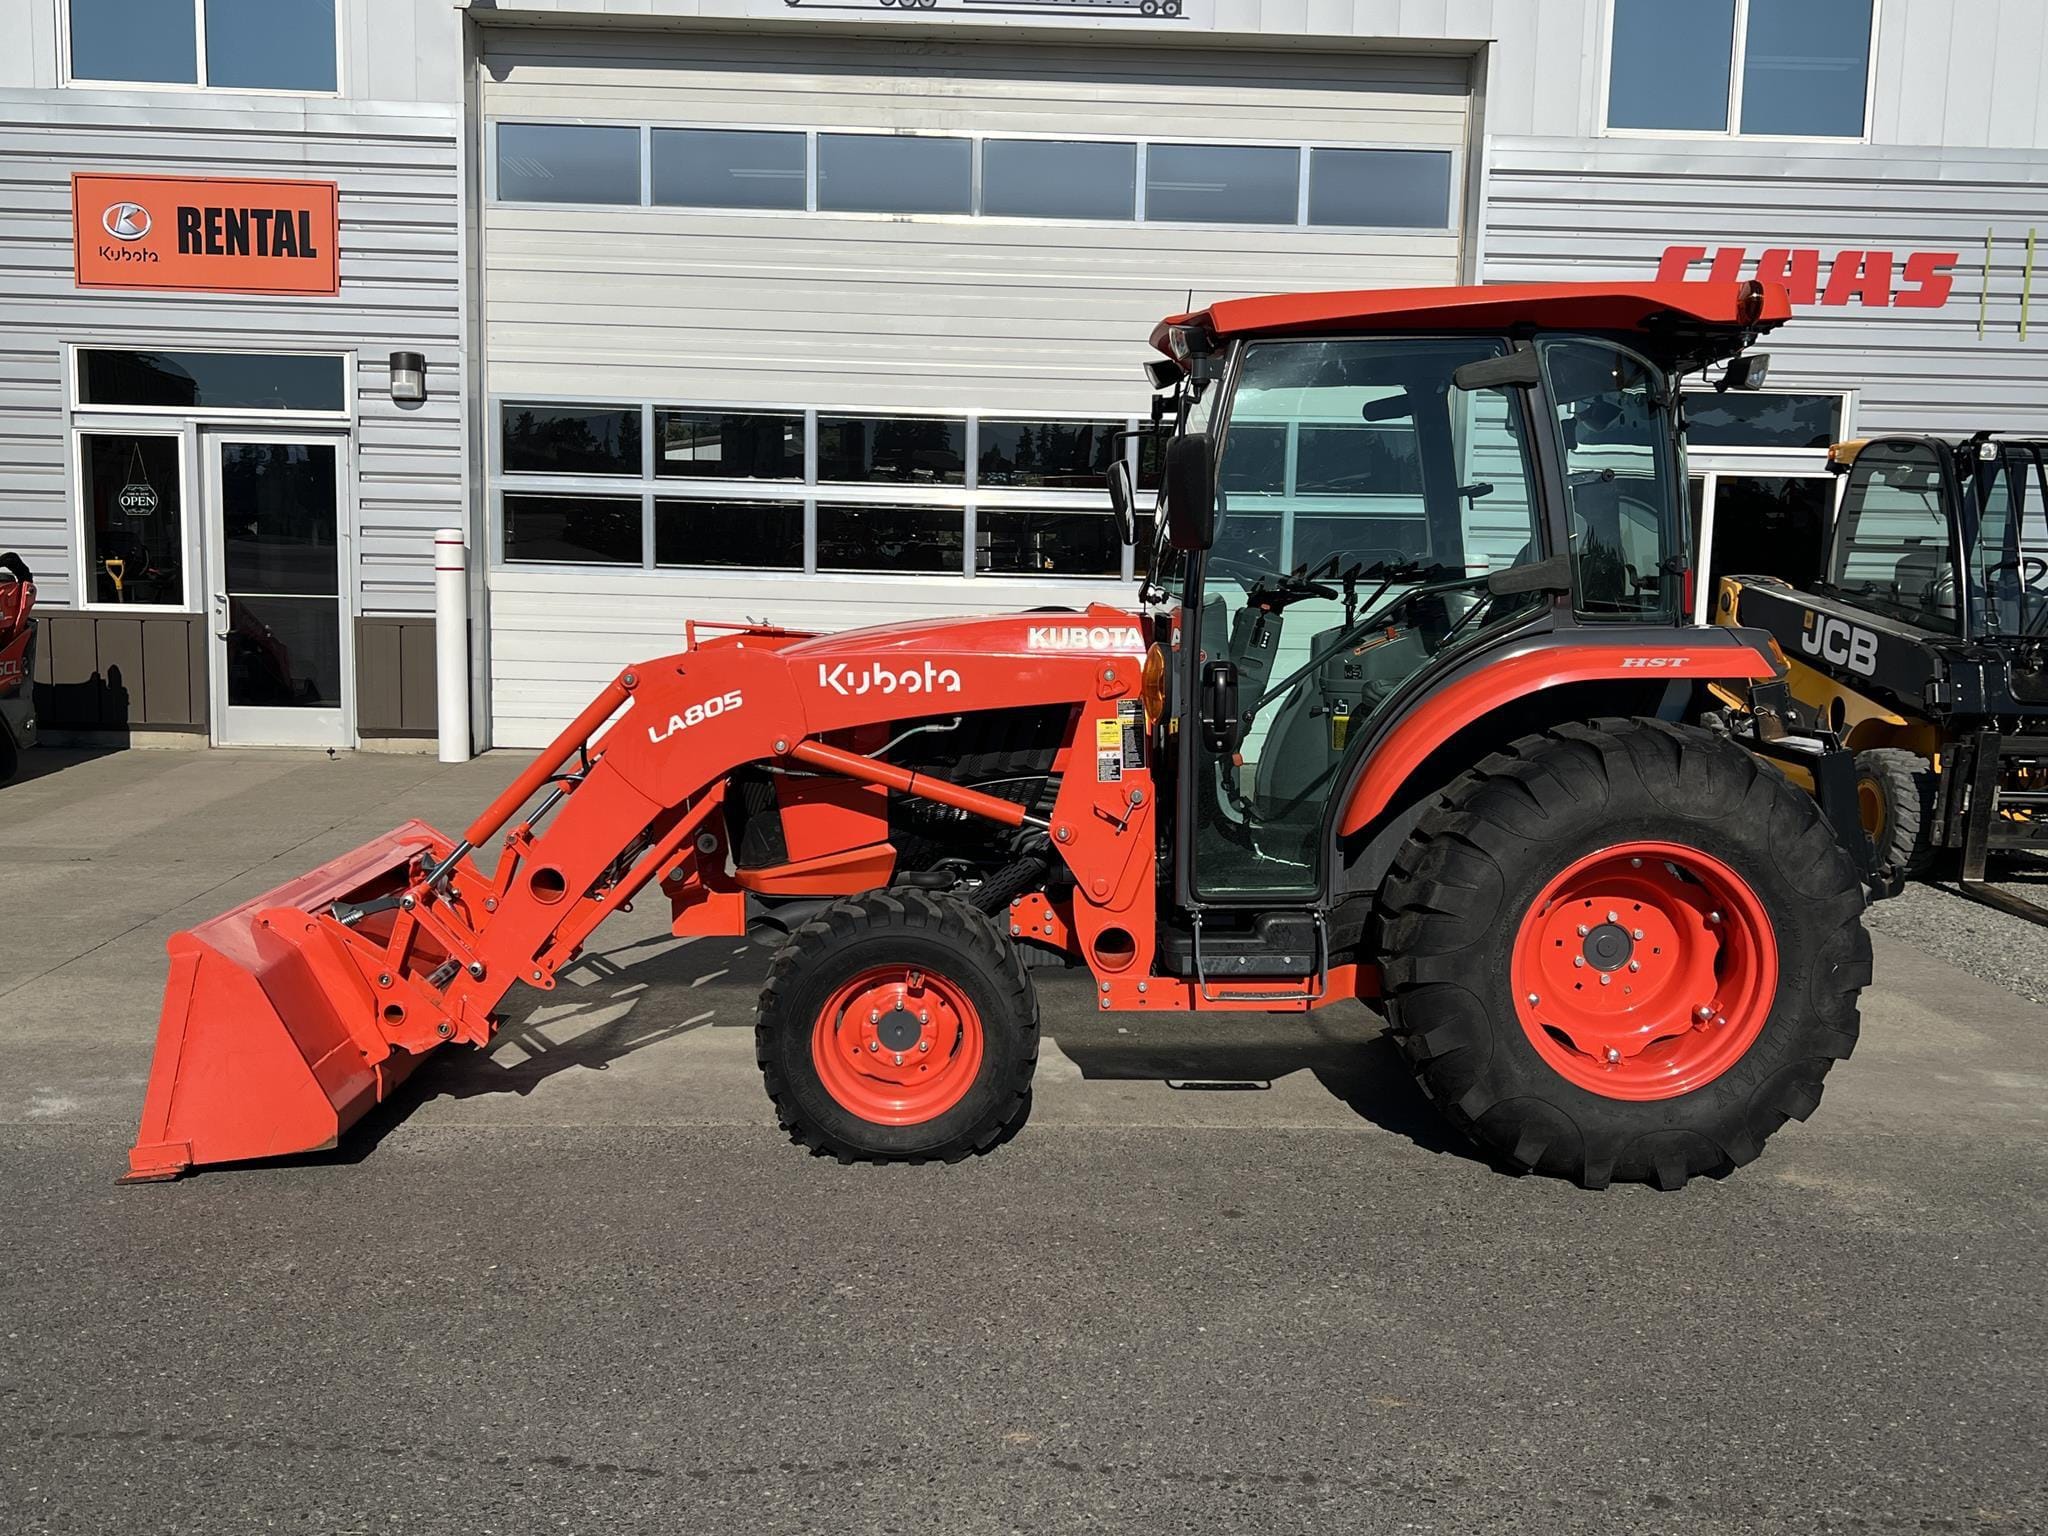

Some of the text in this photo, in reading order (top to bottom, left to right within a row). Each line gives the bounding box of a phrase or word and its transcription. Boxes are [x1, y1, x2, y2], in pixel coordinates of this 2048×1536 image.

[177, 206, 317, 259] RENTAL
[99, 246, 159, 263] Kubota
[121, 496, 155, 506] OPEN
[1028, 627, 1145, 649] KUBOTA
[1802, 614, 1879, 677] JCB
[819, 661, 961, 695] Kubota
[1619, 657, 1690, 668] HST
[648, 690, 743, 743] LA805
[1714, 1014, 1800, 1111] TITAN
